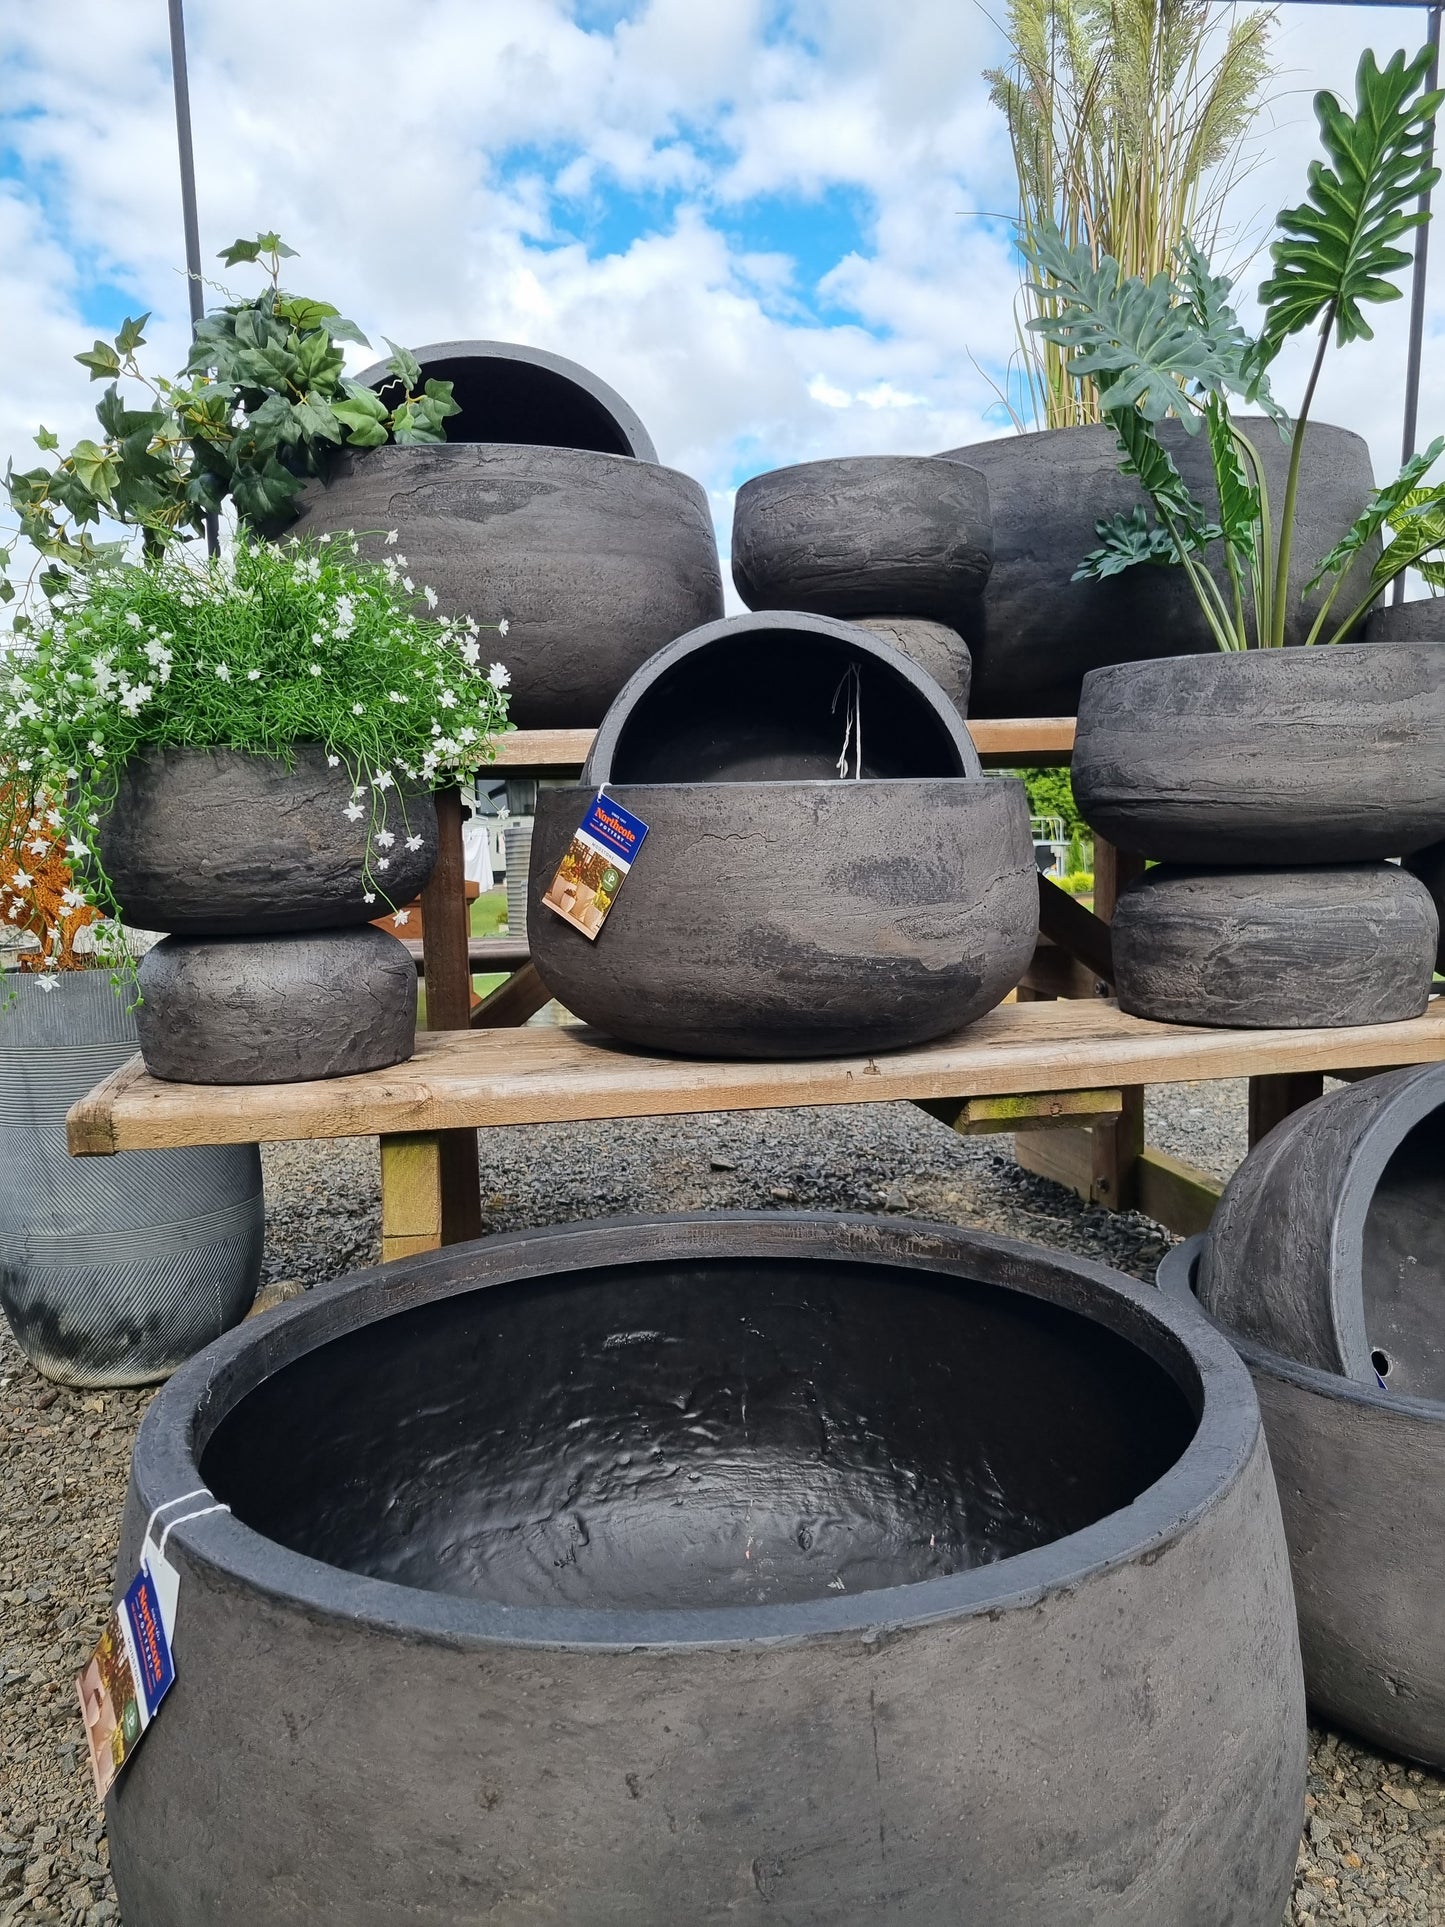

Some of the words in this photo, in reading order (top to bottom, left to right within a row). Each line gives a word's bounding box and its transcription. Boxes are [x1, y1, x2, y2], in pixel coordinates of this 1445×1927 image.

[595, 807, 636, 842] Northcote
[599, 822, 624, 842] POTTERY
[138, 1584, 163, 1682] Northcote
[138, 1612, 152, 1669] POTTERY
